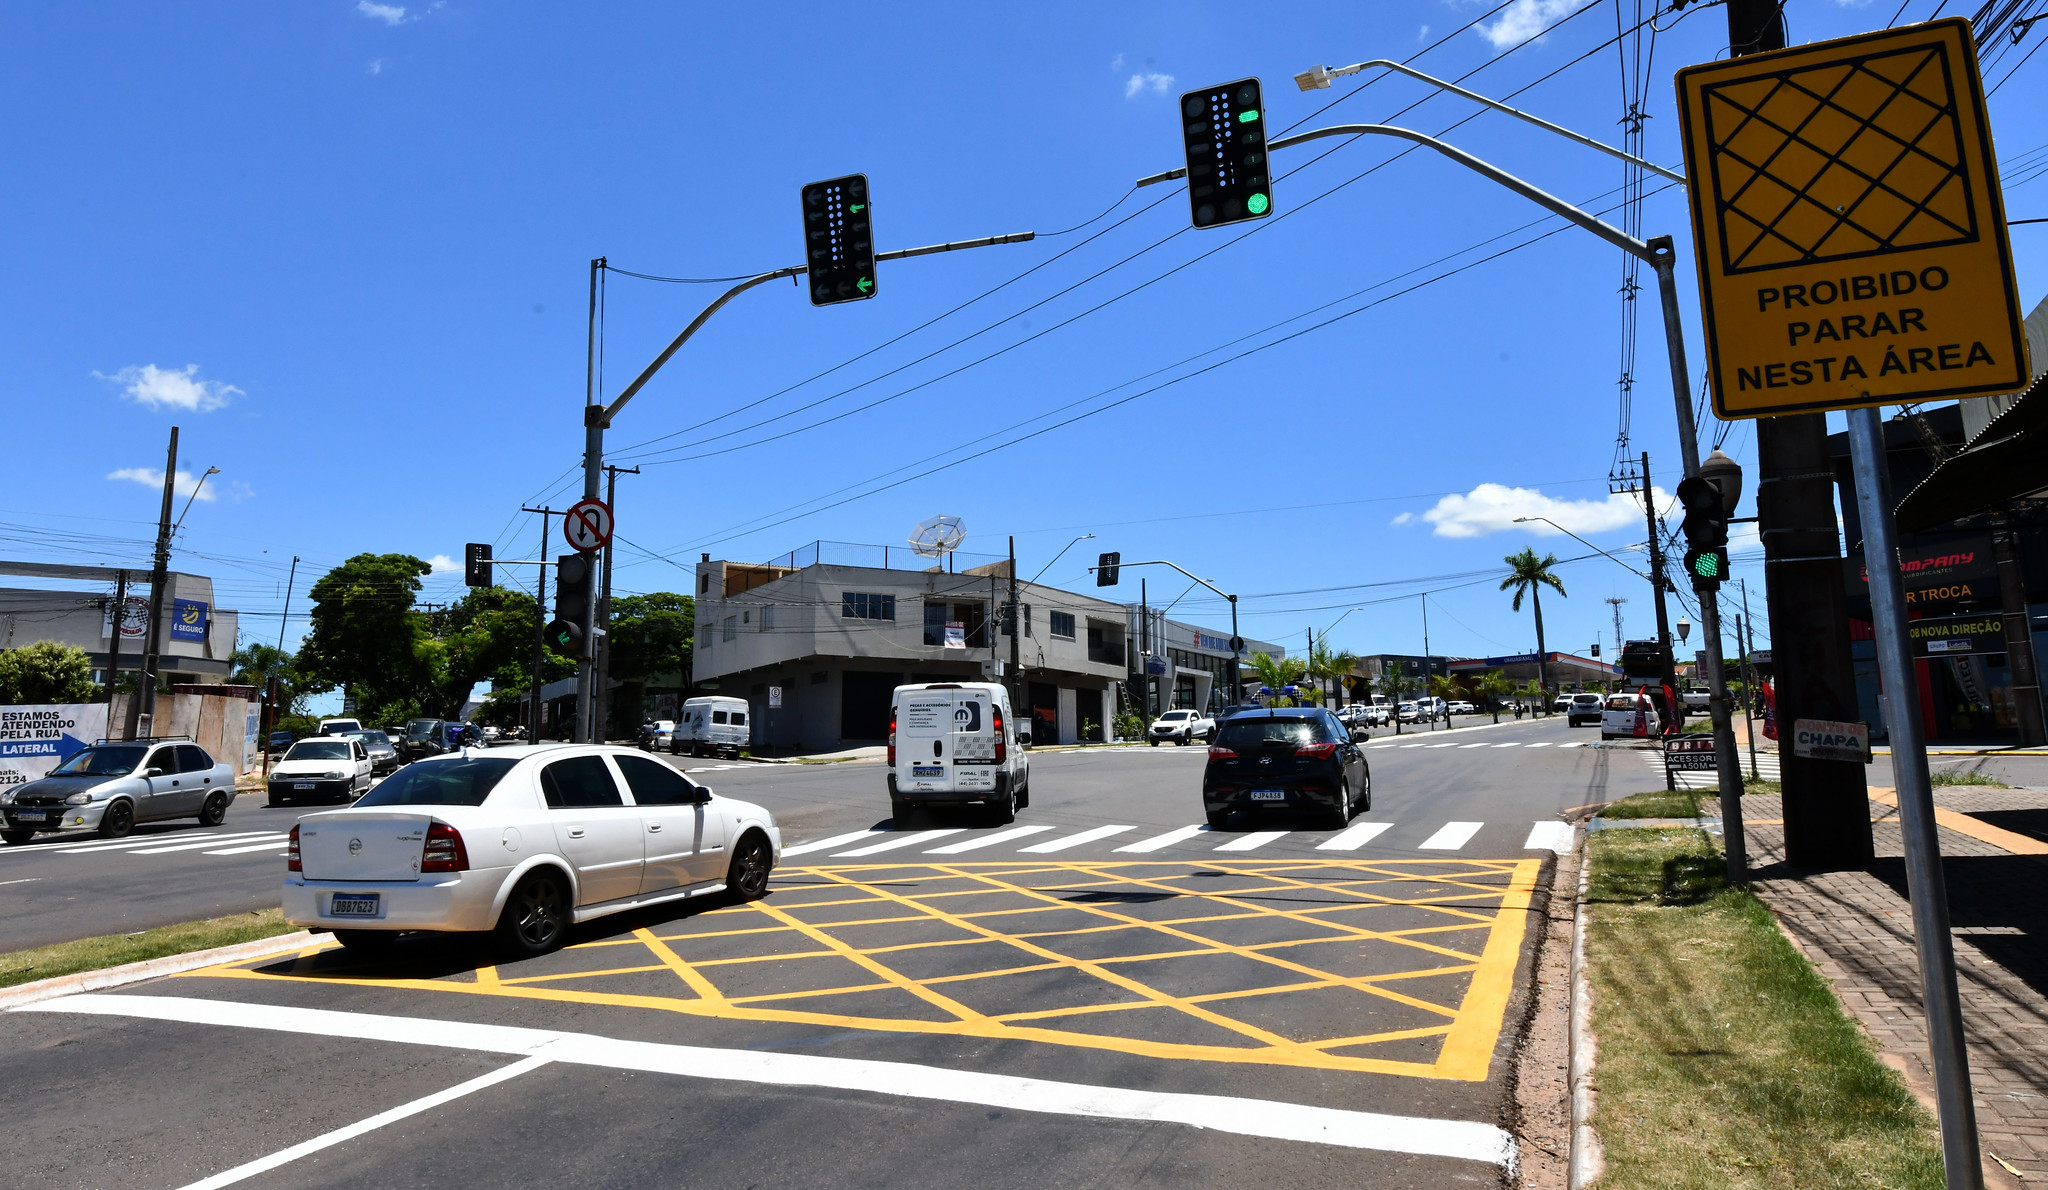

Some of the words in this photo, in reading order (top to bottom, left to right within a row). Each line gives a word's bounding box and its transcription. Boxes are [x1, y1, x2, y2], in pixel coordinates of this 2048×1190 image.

[1757, 266, 1950, 312] PROIBIDO
[1787, 307, 1928, 347] PARAR
[1737, 354, 1869, 392] NESTA
[1878, 341, 1996, 377] ÁREA
[1903, 567, 1953, 579] LUBRIFICANTES
[1906, 591, 1917, 604] R
[1919, 584, 1973, 601] TROCA
[178, 624, 204, 634] SEGURO
[1909, 627, 1920, 639] OB
[1921, 625, 1950, 637] NOVA
[1952, 620, 2002, 636] DIREÇÃO
[2, 711, 60, 721] ESTAMOS
[1, 720, 75, 730] ATENDENDO
[0, 730, 32, 739] PELA
[35, 729, 61, 738] RUA
[1798, 731, 1860, 748] CHAPA
[2, 744, 57, 755] LATERAL
[1671, 741, 1715, 750] BRIT
[1667, 754, 1716, 763] ACESSÓRI
[335, 901, 374, 913] DBB7G23
